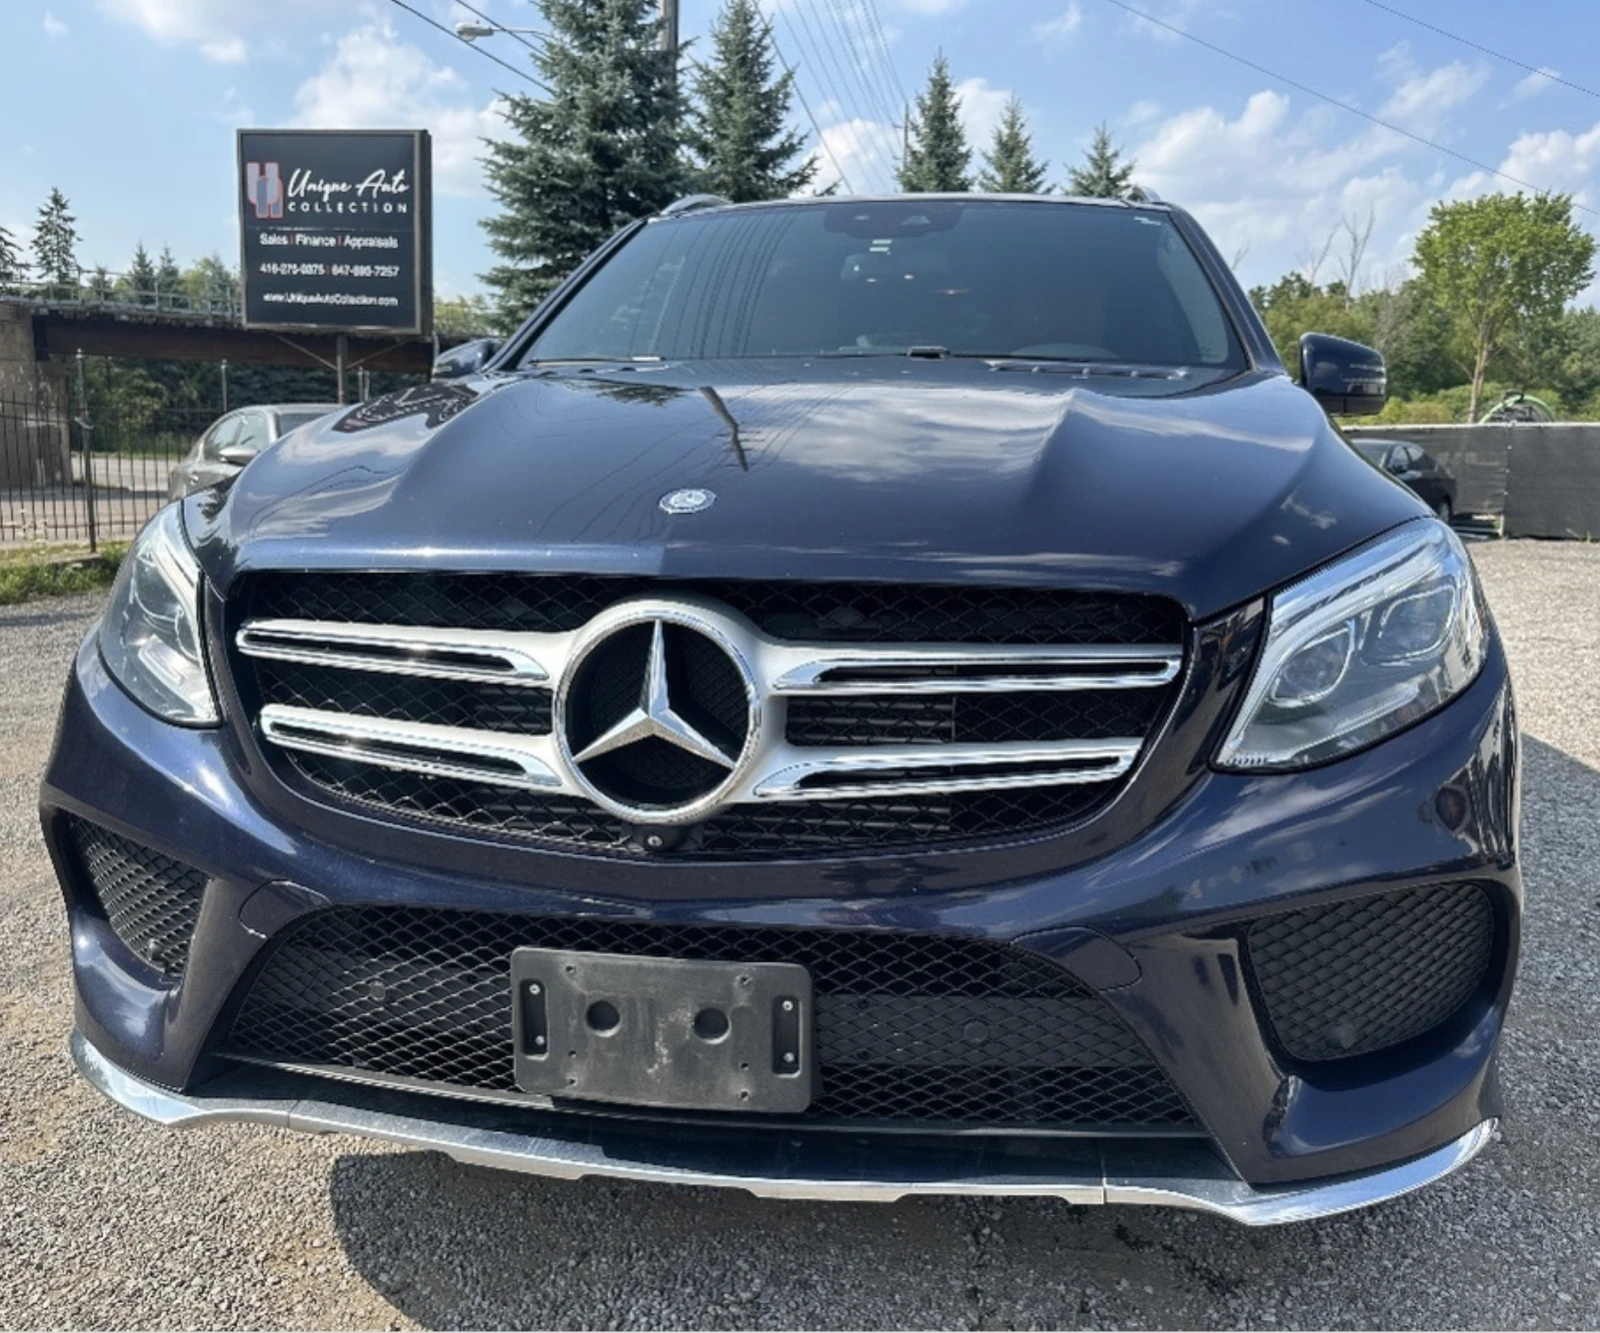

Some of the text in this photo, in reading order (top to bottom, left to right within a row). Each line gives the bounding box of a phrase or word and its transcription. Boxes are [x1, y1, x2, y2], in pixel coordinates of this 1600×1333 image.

[287, 168, 410, 203] Unique Auto
[287, 202, 408, 214] COLLECTION
[260, 233, 398, 249] Sales Finance Appraisals
